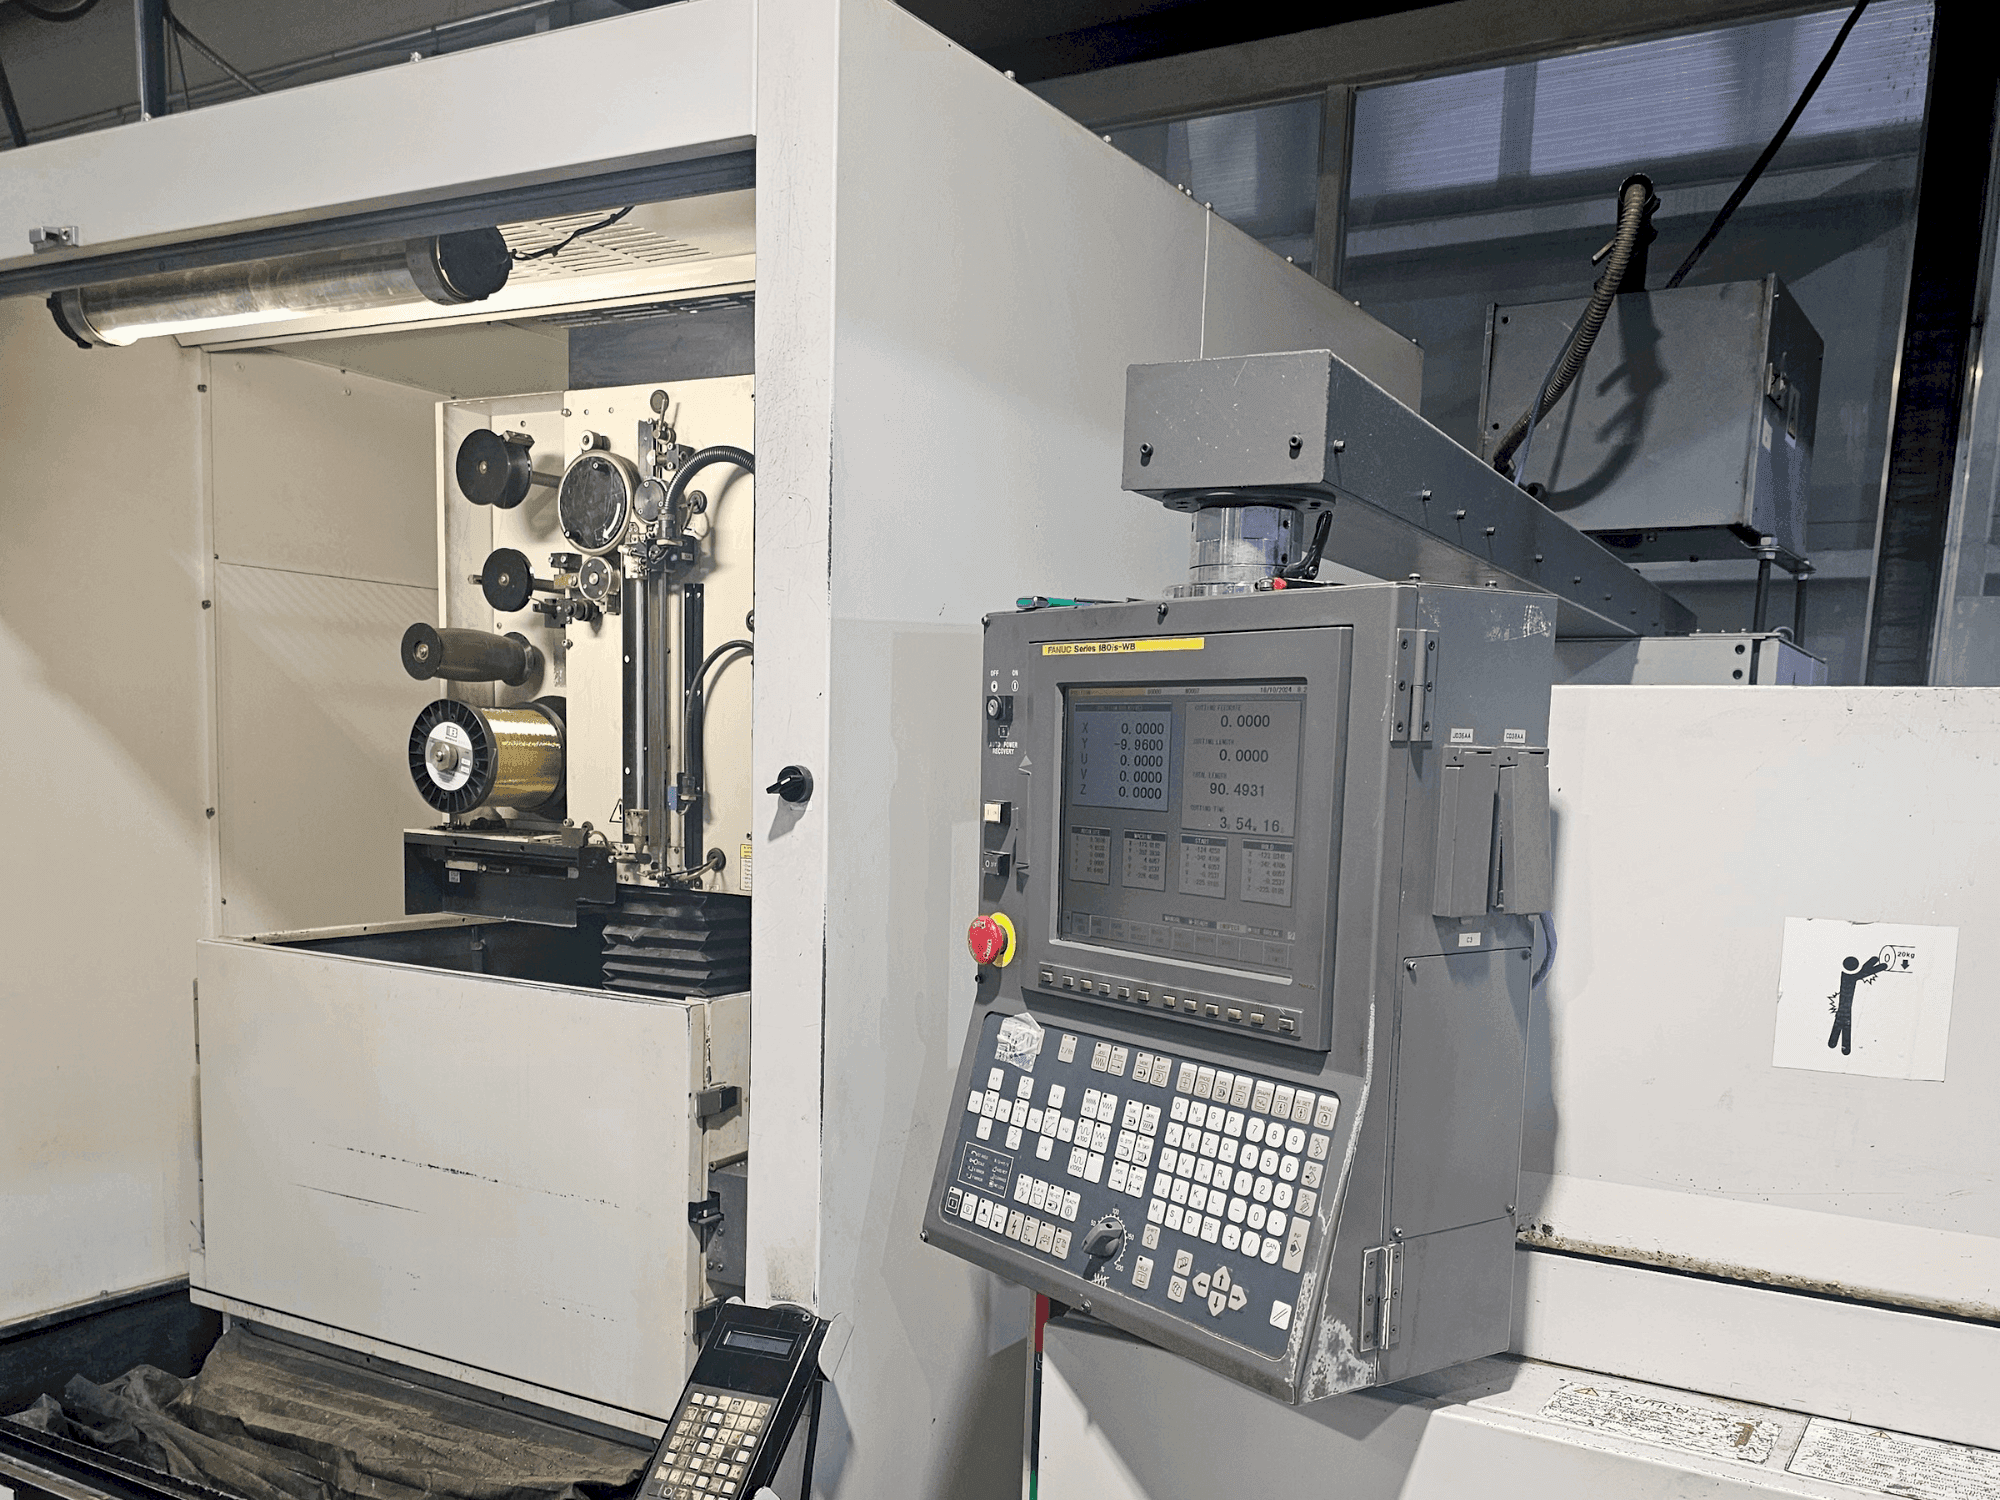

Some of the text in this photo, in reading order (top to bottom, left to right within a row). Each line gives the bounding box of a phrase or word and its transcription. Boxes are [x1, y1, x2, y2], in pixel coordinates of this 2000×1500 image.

[1048, 645, 1071, 654] FANUC
[1074, 645, 1096, 654] Series
[1221, 715, 1270, 728] 0.0000
[1082, 722, 1164, 734] X 0.0000
[1082, 738, 1163, 751] Y -9.9600
[1081, 753, 1163, 767] U 0.0000
[1220, 749, 1268, 762] 0.0000
[1081, 769, 1162, 783] V 0.0000
[1080, 784, 1161, 799] Z 0.0000
[1210, 783, 1265, 797] 90.4931
[1252, 1125, 1258, 1134] 7
[1188, 1132, 1192, 1140] Y
[1272, 1130, 1277, 1139] 8
[1292, 1136, 1298, 1145] 9
[1163, 1153, 1169, 1162] U
[1246, 1152, 1251, 1161] 4
[1266, 1158, 1271, 1167] 5
[1286, 1163, 1292, 1173] 6
[1242, 1179, 1244, 1188] 1
[1260, 1184, 1265, 1194] 2
[1194, 1190, 1199, 1198] K
[1280, 1191, 1285, 1200] 3
[1212, 1196, 1216, 1204] L
[1152, 1204, 1158, 1212] M
[1188, 1216, 1193, 1224] D
[1254, 1212, 1259, 1221] 0
[1266, 1242, 1277, 1250] CAN
[1115, 1264, 1124, 1272] 200
[1610, 1393, 1689, 1413] CAUTION
